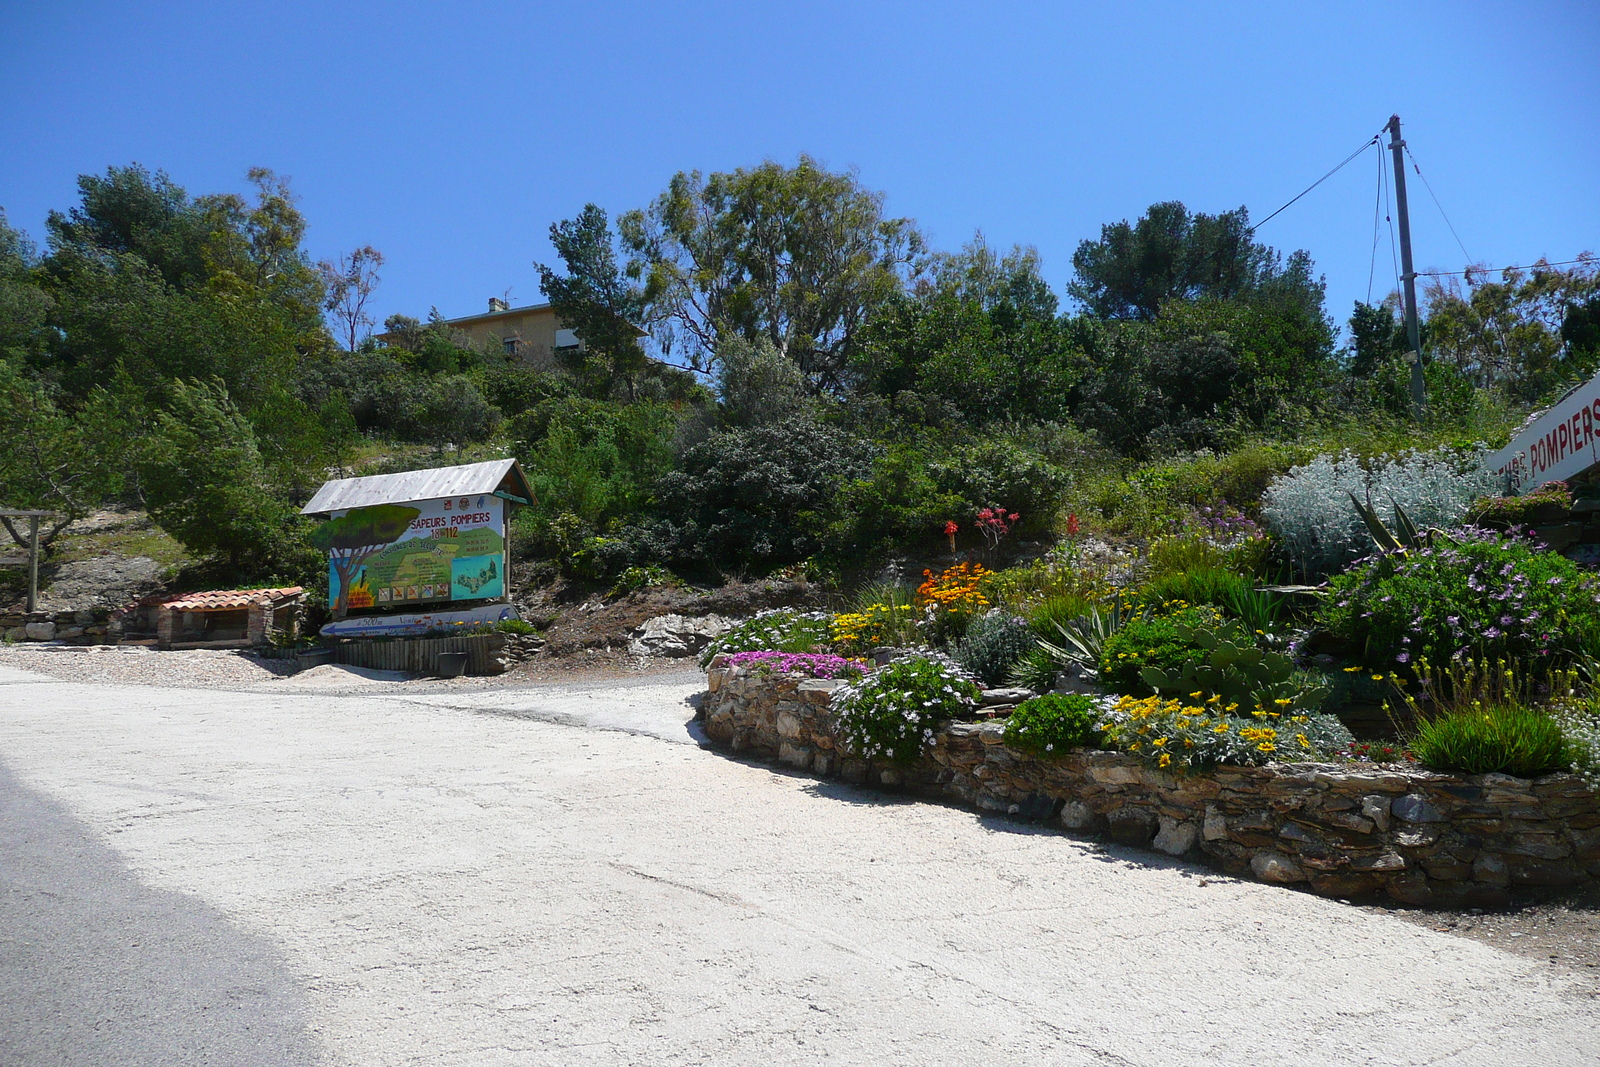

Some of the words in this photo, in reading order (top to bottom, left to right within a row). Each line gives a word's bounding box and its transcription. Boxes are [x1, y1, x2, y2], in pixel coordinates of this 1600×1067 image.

[1530, 397, 1600, 478] POMPIERS
[411, 517, 447, 529] SAPEURS
[451, 512, 490, 525] POMPIERS
[431, 528, 440, 540] 18
[445, 526, 458, 538] 112
[409, 541, 417, 549] DE
